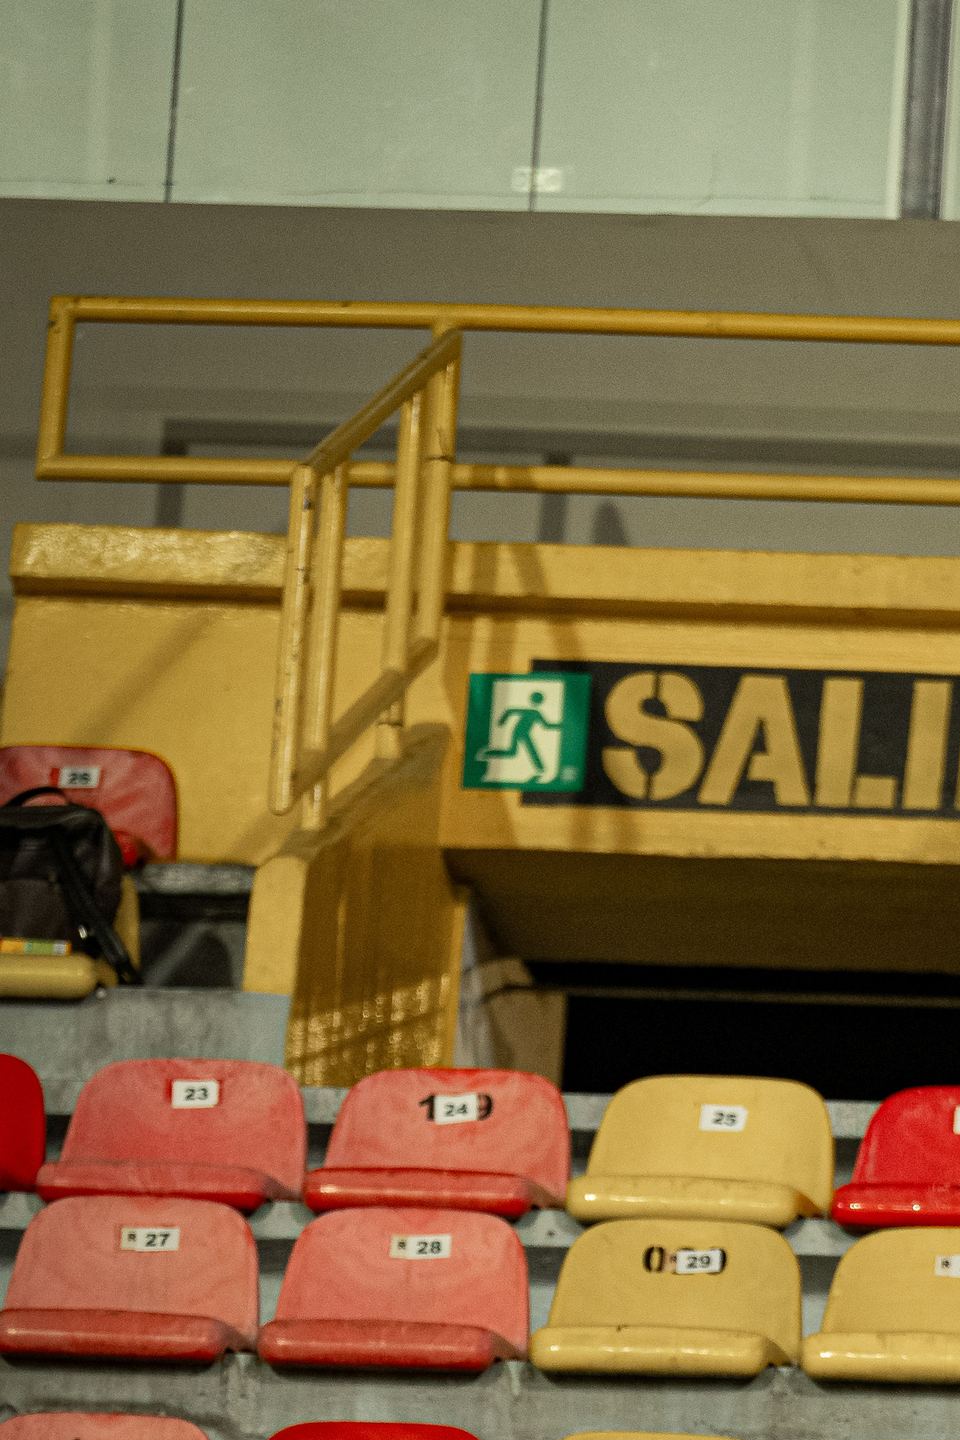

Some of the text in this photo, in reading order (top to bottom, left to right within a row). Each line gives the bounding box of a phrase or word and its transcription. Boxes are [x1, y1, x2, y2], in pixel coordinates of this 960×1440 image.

[184, 1087, 209, 1101] 23
[713, 1111, 737, 1127] 25
[145, 1232, 171, 1248] 27
[417, 1240, 442, 1255] 28
[687, 1255, 712, 1269] 29
